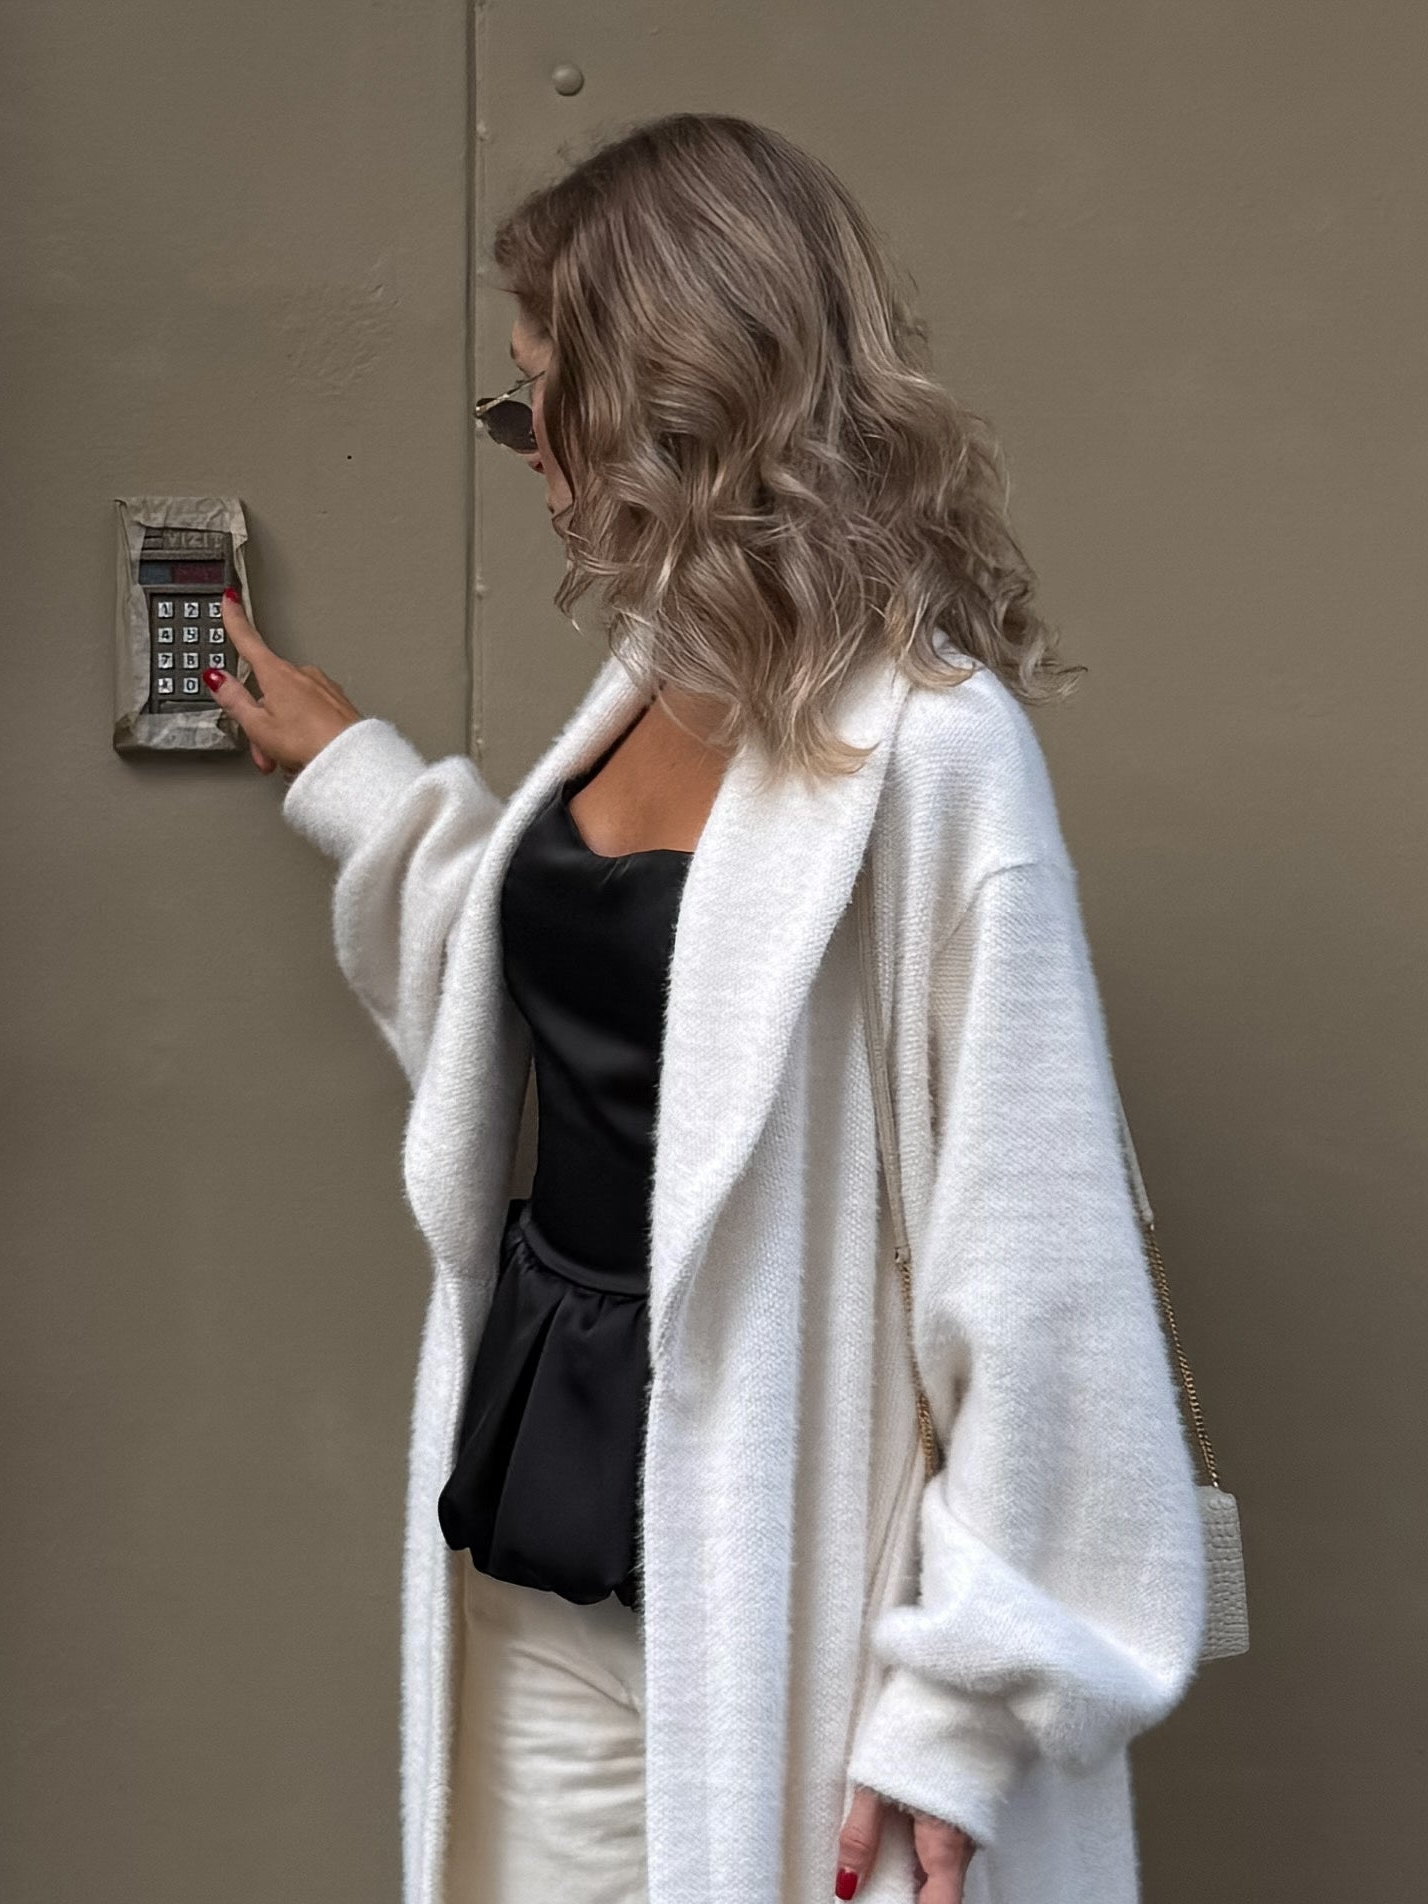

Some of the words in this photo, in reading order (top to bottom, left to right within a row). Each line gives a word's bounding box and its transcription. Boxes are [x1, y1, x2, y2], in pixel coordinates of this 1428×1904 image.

[165, 529, 224, 548] VIZIT
[212, 629, 222, 641] 6
[186, 679, 196, 690] 0
